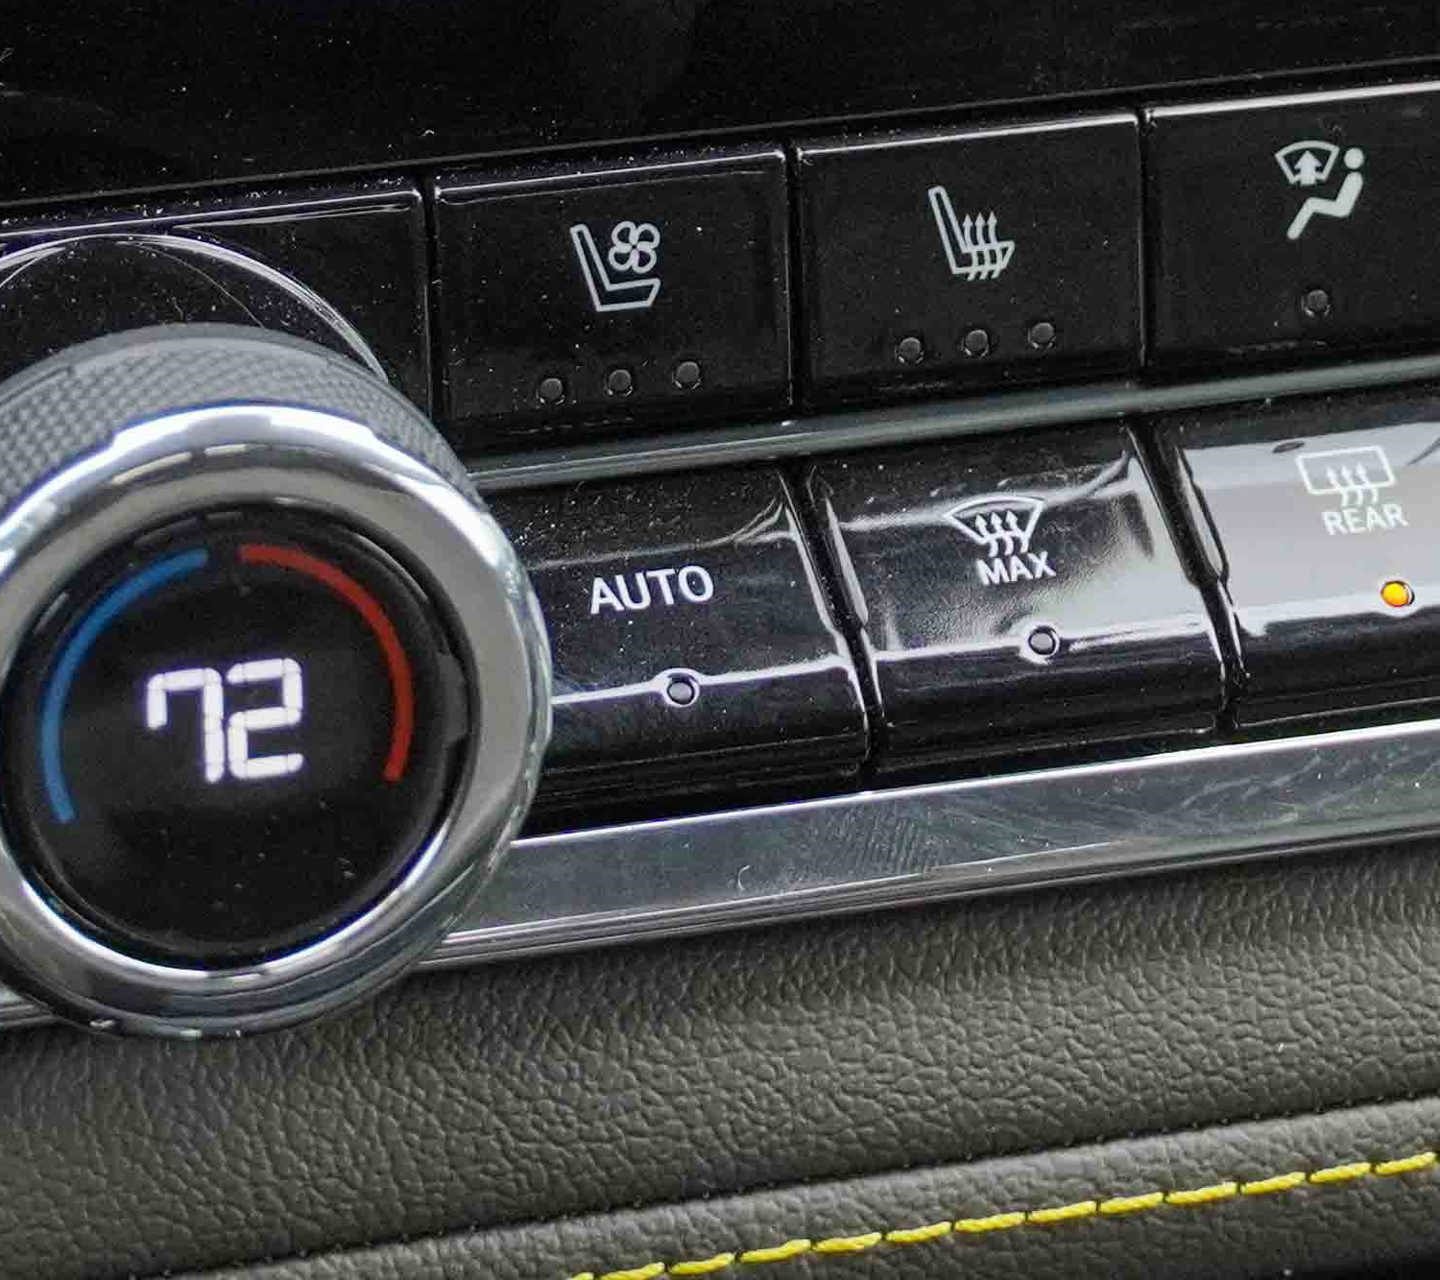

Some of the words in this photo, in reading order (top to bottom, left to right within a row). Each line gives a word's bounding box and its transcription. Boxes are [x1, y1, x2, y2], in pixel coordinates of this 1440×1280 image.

[1321, 503, 1408, 535] REAR
[977, 551, 1056, 585] MAX
[590, 565, 714, 615] AUTO
[146, 658, 304, 783] 72
